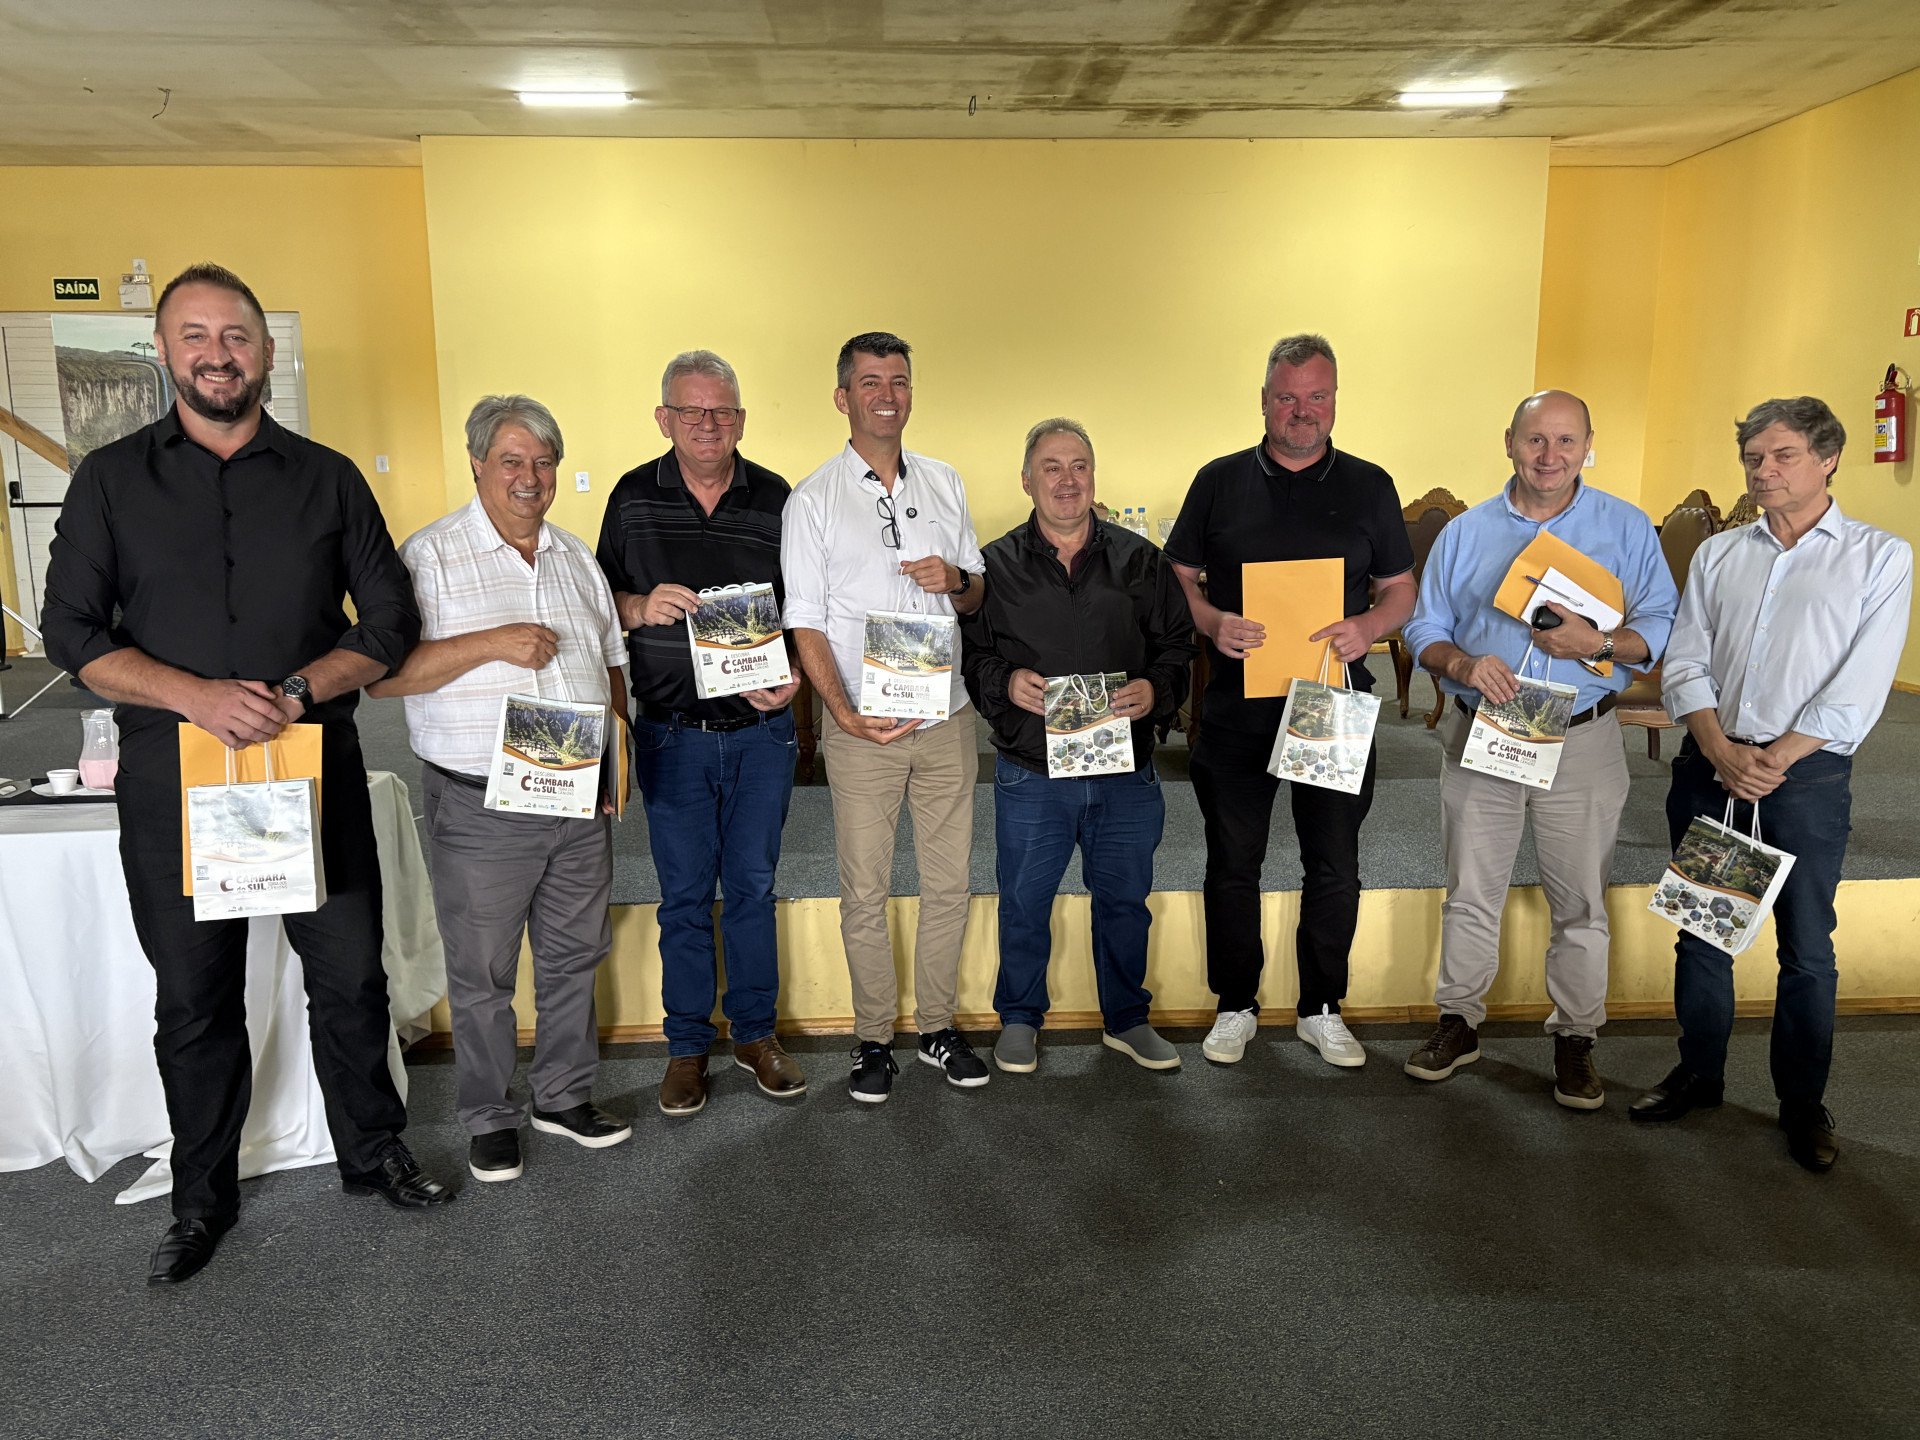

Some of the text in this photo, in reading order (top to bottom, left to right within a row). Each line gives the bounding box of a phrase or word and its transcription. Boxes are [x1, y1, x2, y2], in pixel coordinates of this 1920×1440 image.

[56, 281, 97, 294] SAÍDA
[732, 653, 768, 666] CAMBARÁ
[741, 664, 754, 672] SUL
[1500, 745, 1537, 759] CAMBARÁ
[1505, 752, 1519, 762] SUL
[533, 777, 574, 787] CAMBARÁ
[542, 785, 557, 794] SUL
[247, 883, 266, 891] SUL
